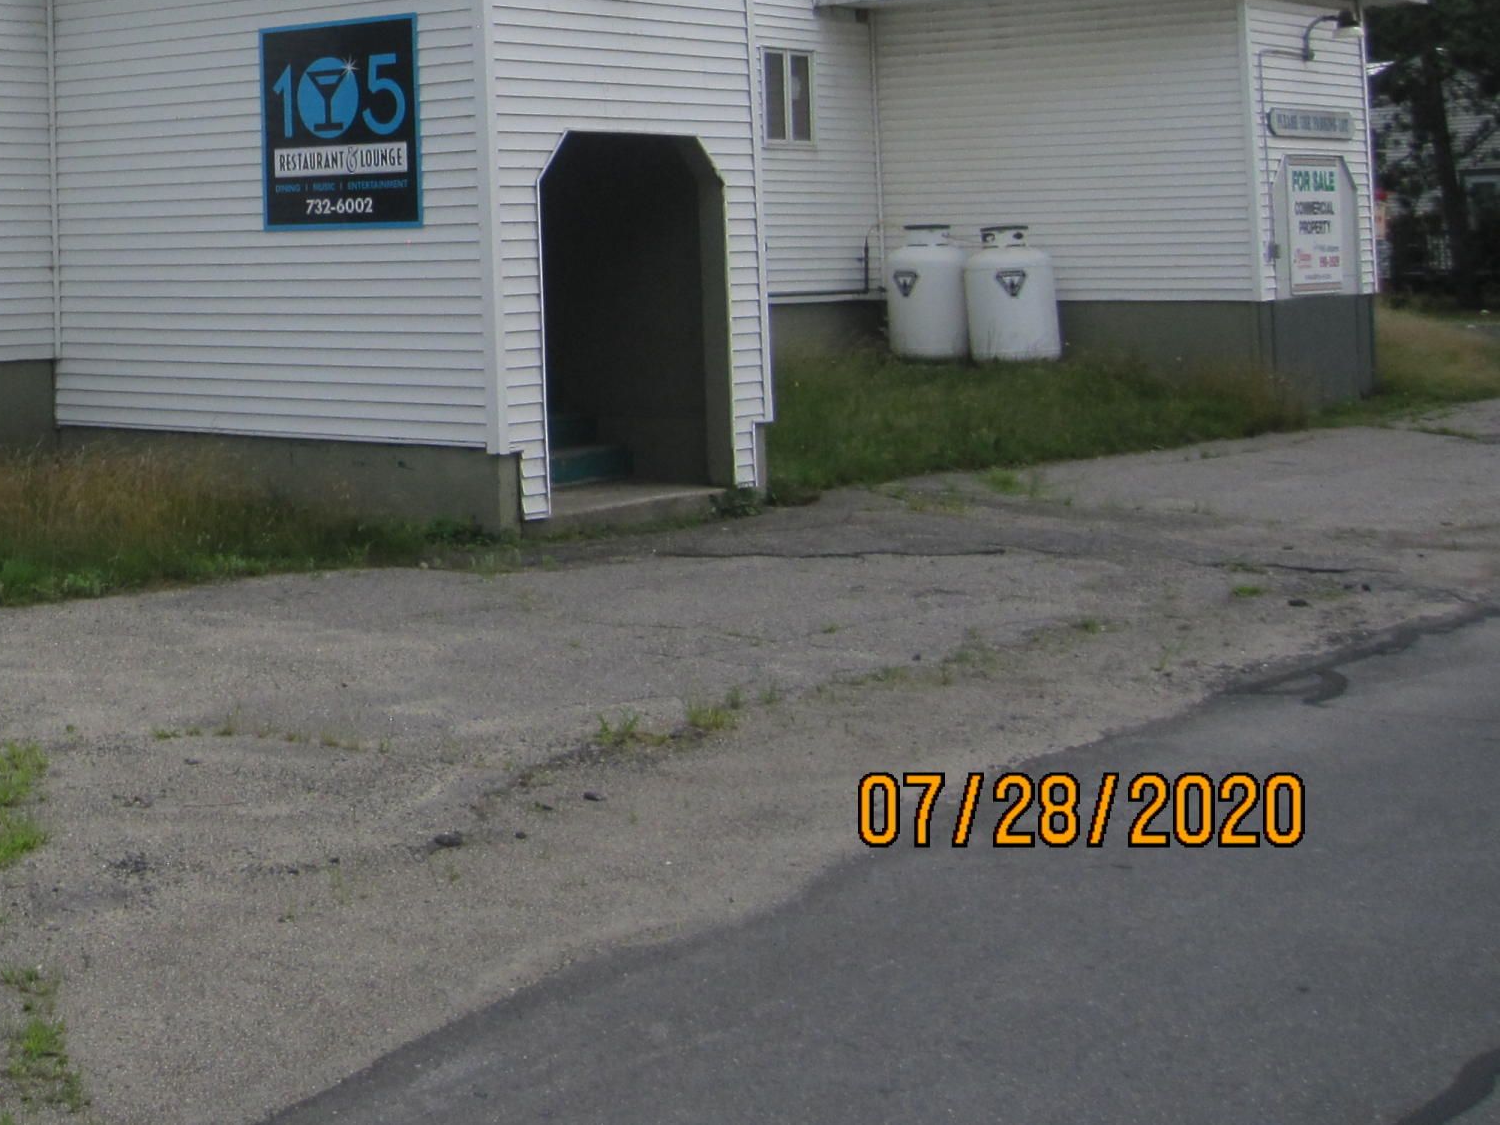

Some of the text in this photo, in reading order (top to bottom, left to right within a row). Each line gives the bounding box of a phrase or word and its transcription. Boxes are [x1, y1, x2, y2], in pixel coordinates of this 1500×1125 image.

[273, 53, 405, 139] 105
[279, 147, 402, 173] RESTAURANT & LOUNGE
[276, 179, 408, 193] DINING MUSIC ENTERTAINMENT
[1292, 171, 1334, 191] FOR SALE
[306, 197, 373, 215] 732-6002
[1295, 201, 1334, 215] COMMERCIAL
[1299, 220, 1330, 235] PROPERTY
